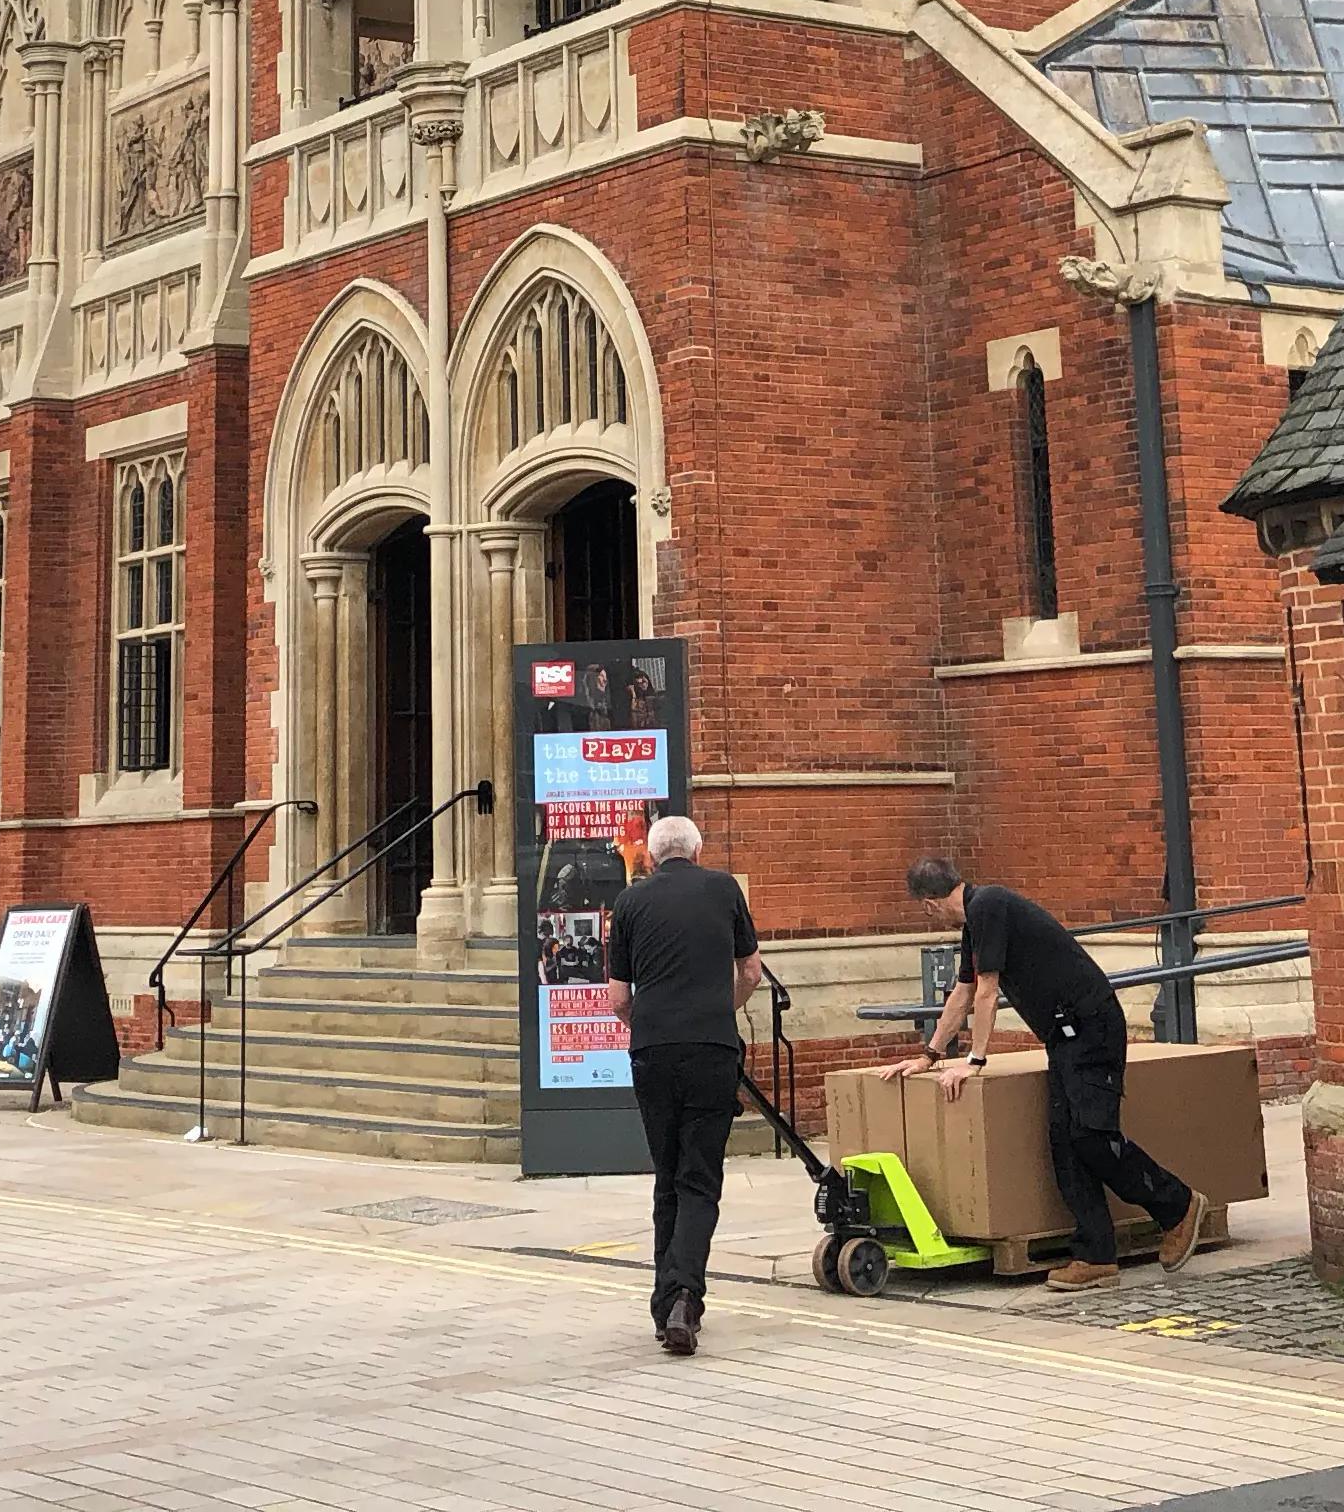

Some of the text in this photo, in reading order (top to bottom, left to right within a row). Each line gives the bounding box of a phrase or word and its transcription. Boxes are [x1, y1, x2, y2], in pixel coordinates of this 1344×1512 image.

[536, 665, 572, 683] RSC
[544, 739, 652, 760] the Play's
[544, 764, 649, 784] the thing
[548, 800, 644, 814] DISCOVER THE MAGIC
[548, 813, 627, 826] OF 100 YEARS OF
[551, 989, 607, 1000] ANNUAL PAS
[552, 1023, 568, 1034] RSC
[572, 1022, 617, 1034] EXPLORER
